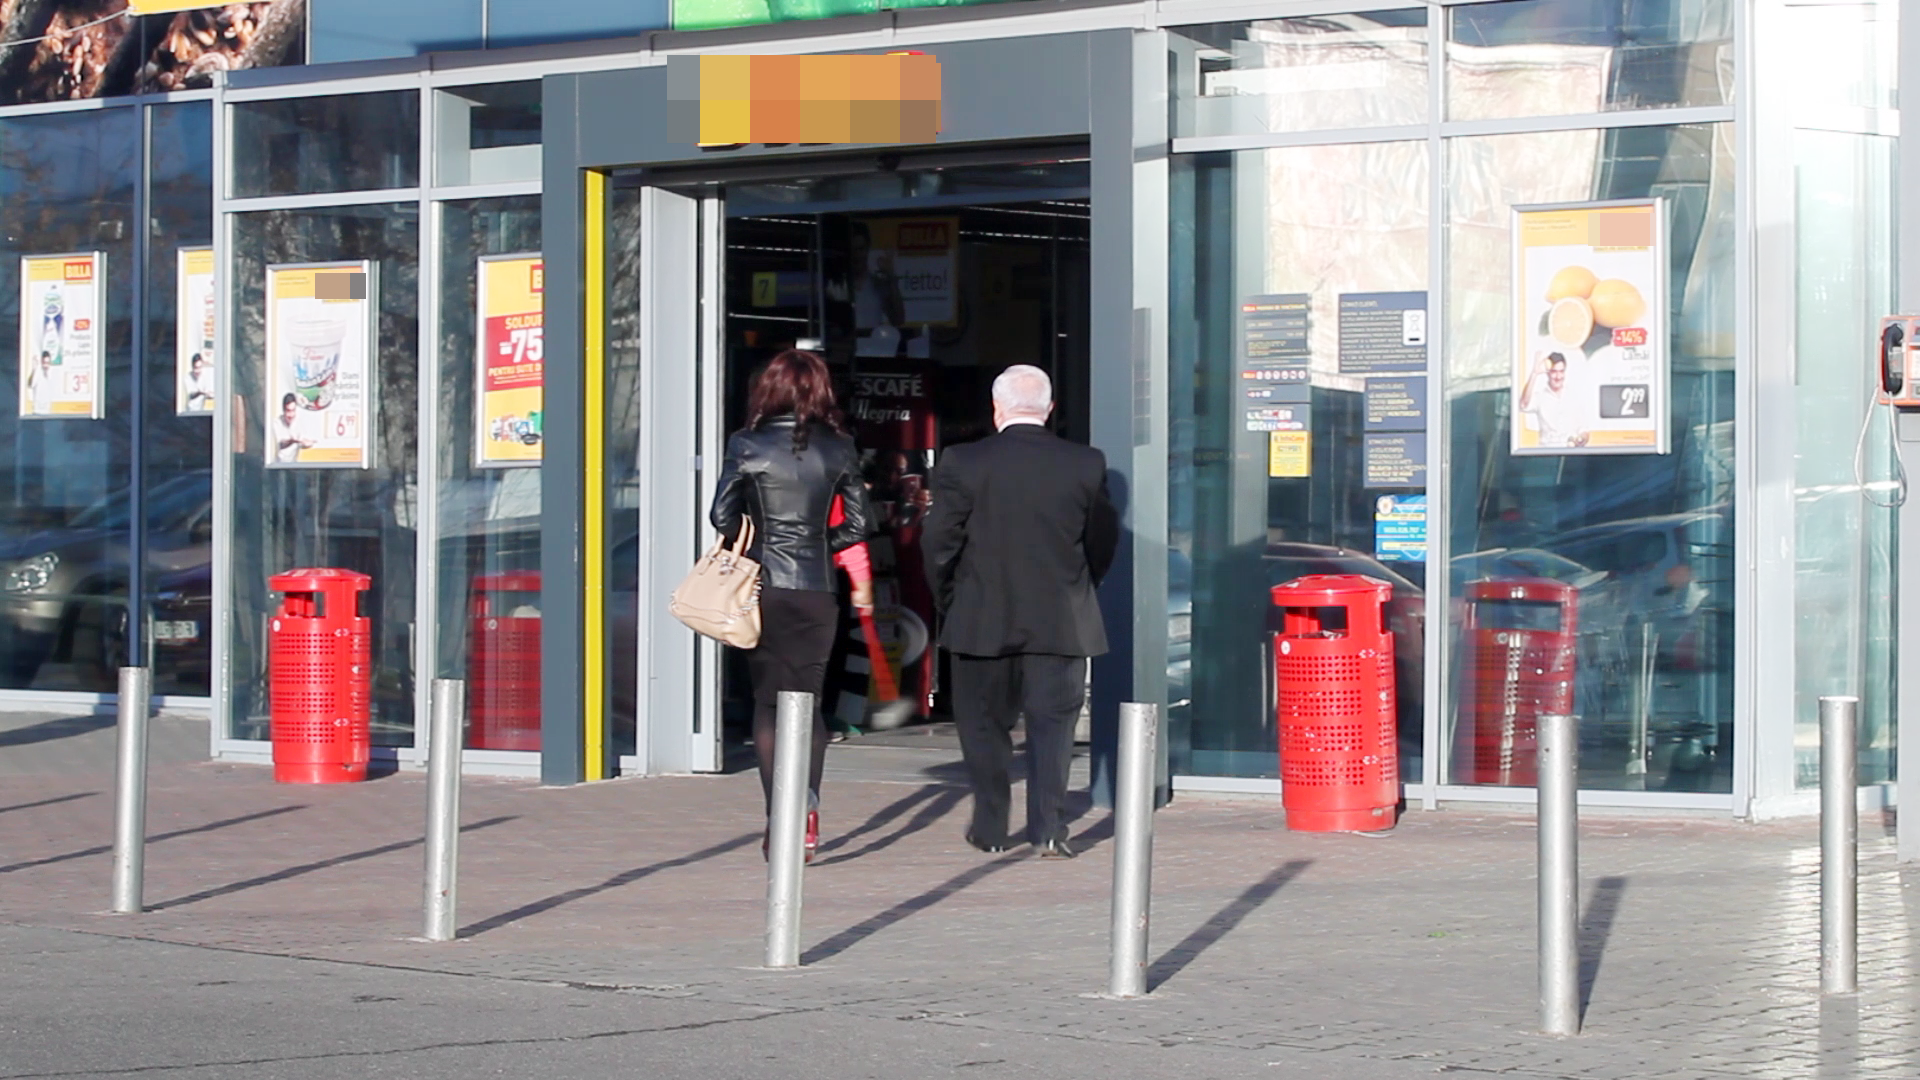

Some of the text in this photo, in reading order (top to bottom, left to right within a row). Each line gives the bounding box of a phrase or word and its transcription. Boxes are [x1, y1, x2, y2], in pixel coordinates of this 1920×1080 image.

[66, 264, 91, 279] BILLA
[759, 279, 769, 299] 7
[1616, 330, 1644, 344] -14%
